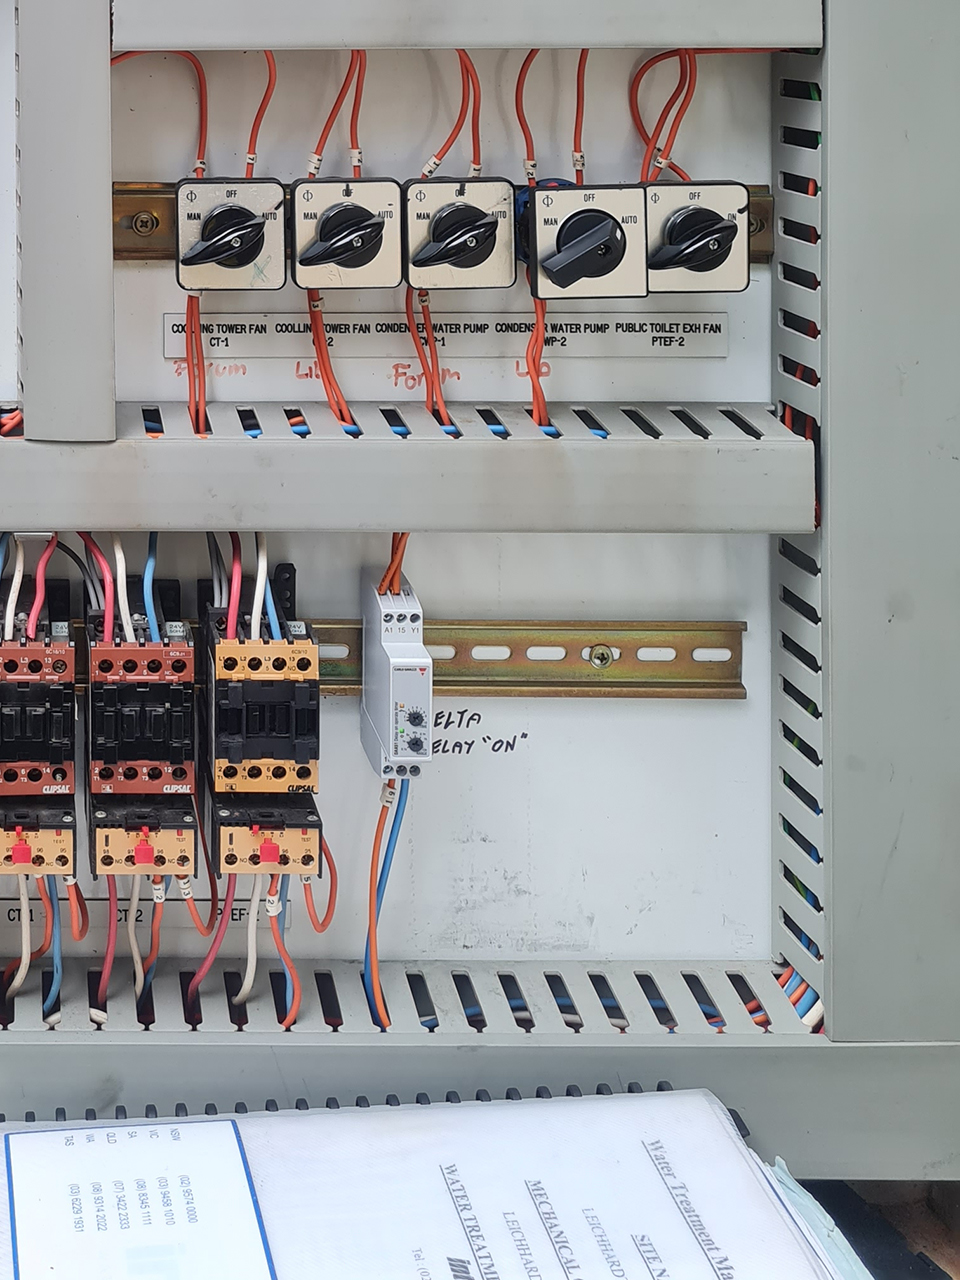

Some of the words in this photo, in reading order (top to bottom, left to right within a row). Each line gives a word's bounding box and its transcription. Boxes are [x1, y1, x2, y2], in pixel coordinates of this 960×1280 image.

[226, 190, 237, 198] OFF
[584, 194, 595, 202] OFF
[689, 192, 701, 200] OFF
[186, 212, 201, 221] MAN
[261, 212, 277, 221] AUTO
[303, 212, 318, 220] MAN
[378, 210, 393, 219] AUTO
[416, 212, 431, 220] MAN
[491, 210, 507, 219] AUTO
[544, 218, 558, 226] MAN
[621, 216, 637, 224] AUTO
[216, 324, 246, 334] TOWER
[249, 324, 267, 334] FAN
[353, 324, 371, 333] FAN
[375, 323, 426, 333] CONDENER
[464, 324, 489, 333] PUMP
[495, 323, 548, 333] CONDENSR
[550, 324, 581, 333] WATER
[584, 324, 610, 333] PUMP
[615, 323, 647, 333] PUBLIC
[649, 323, 680, 333] TOILET
[683, 324, 701, 333] EXH
[703, 324, 722, 333] FAN
[210, 337, 229, 347] CT-1
[652, 336, 685, 346] PTEF-2
[433, 709, 482, 729] ELTA
[432, 739, 476, 755] ELAY
[42, 785, 70, 794] CLIPSAL
[163, 785, 191, 793] CLIPSAL
[287, 784, 315, 792] CLIPSAL
[86, 1133, 95, 1143] WA
[106, 1132, 117, 1144] QLD
[127, 1130, 138, 1139] SA
[149, 1129, 160, 1139] VIC
[170, 1128, 181, 1142] NSW
[64, 1135, 74, 1147] TAS
[444, 1163, 473, 1212] WATER
[648, 1139, 677, 1179] Water
[671, 1182, 721, 1253] Treatment
[528, 1180, 581, 1275] MECHANICAL
[582, 1208, 628, 1280] LEICHHARD
[635, 1234, 663, 1264] SITE
